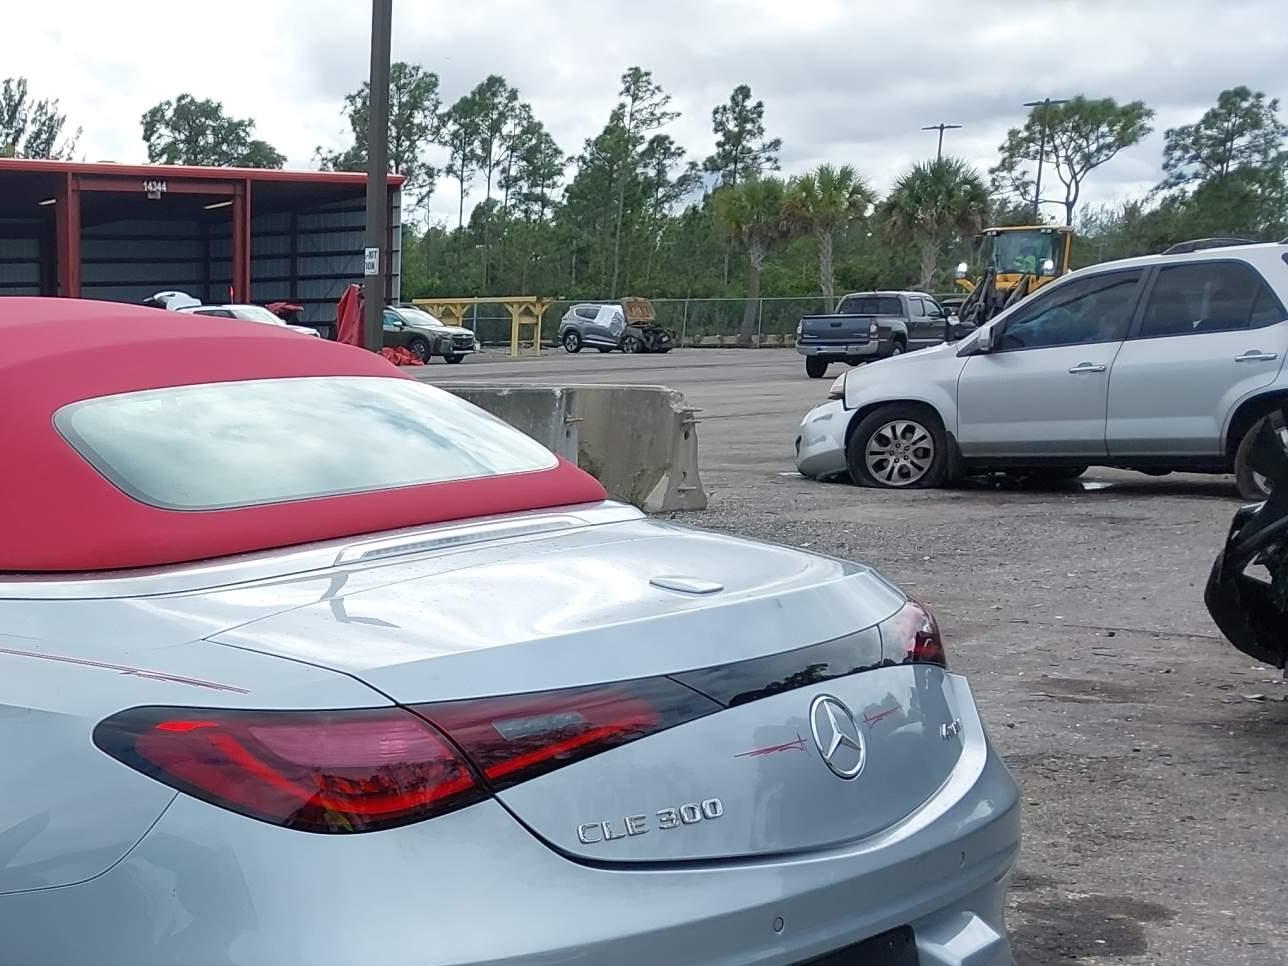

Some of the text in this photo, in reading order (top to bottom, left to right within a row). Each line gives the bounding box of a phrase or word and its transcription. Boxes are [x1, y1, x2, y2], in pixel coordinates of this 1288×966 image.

[143, 180, 167, 192] 14344
[577, 798, 724, 844] CLE 300
